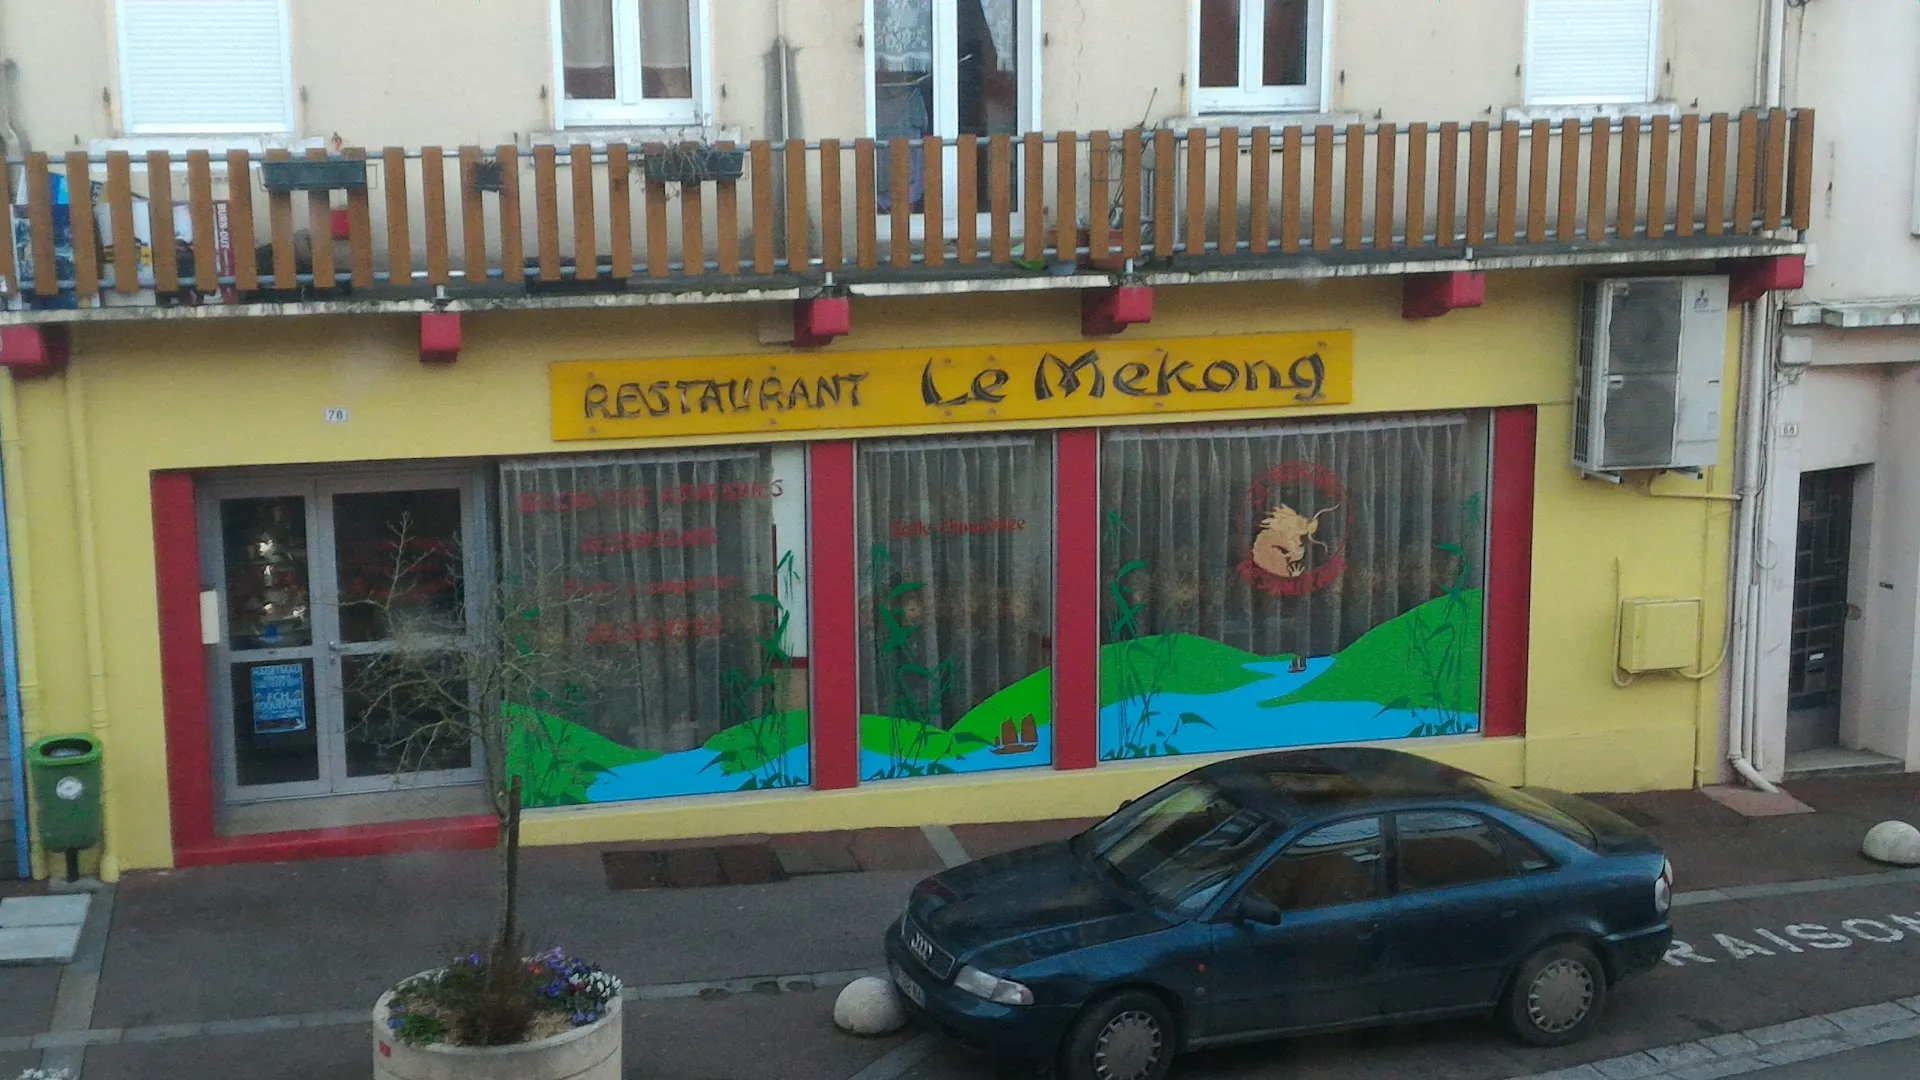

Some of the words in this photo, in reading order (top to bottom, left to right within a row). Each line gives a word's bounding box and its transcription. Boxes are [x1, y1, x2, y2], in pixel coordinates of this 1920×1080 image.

[217, 203, 229, 249] BURN-OUT
[584, 371, 868, 419] RESTAURANT
[921, 356, 1010, 407] Le
[1035, 348, 1326, 404] Mekong
